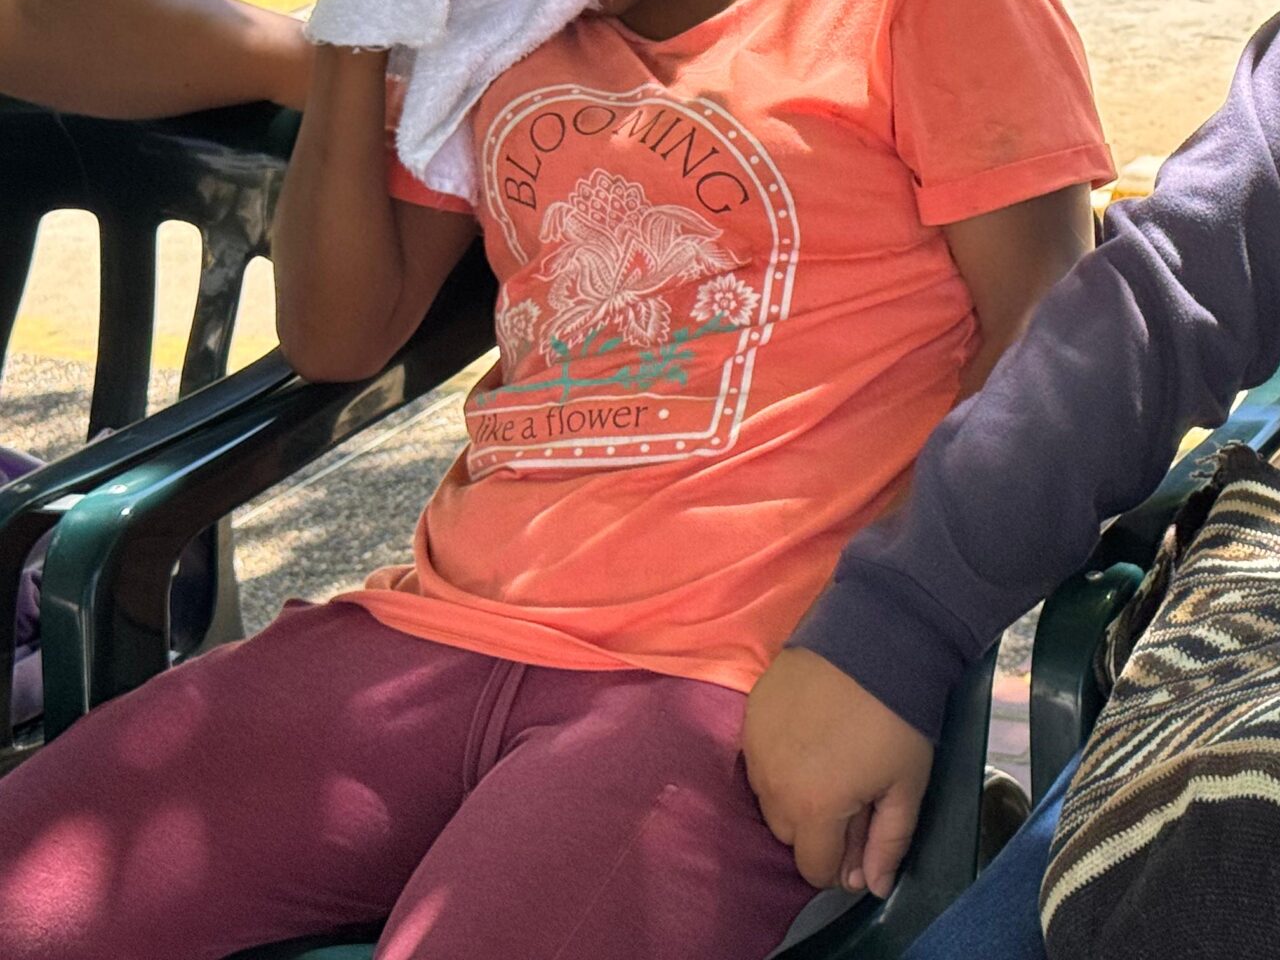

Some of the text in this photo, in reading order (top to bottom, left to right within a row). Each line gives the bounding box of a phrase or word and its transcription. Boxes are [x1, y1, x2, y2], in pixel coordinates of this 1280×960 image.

[504, 103, 750, 217] BLOOMING
[475, 405, 649, 443] like a flower
